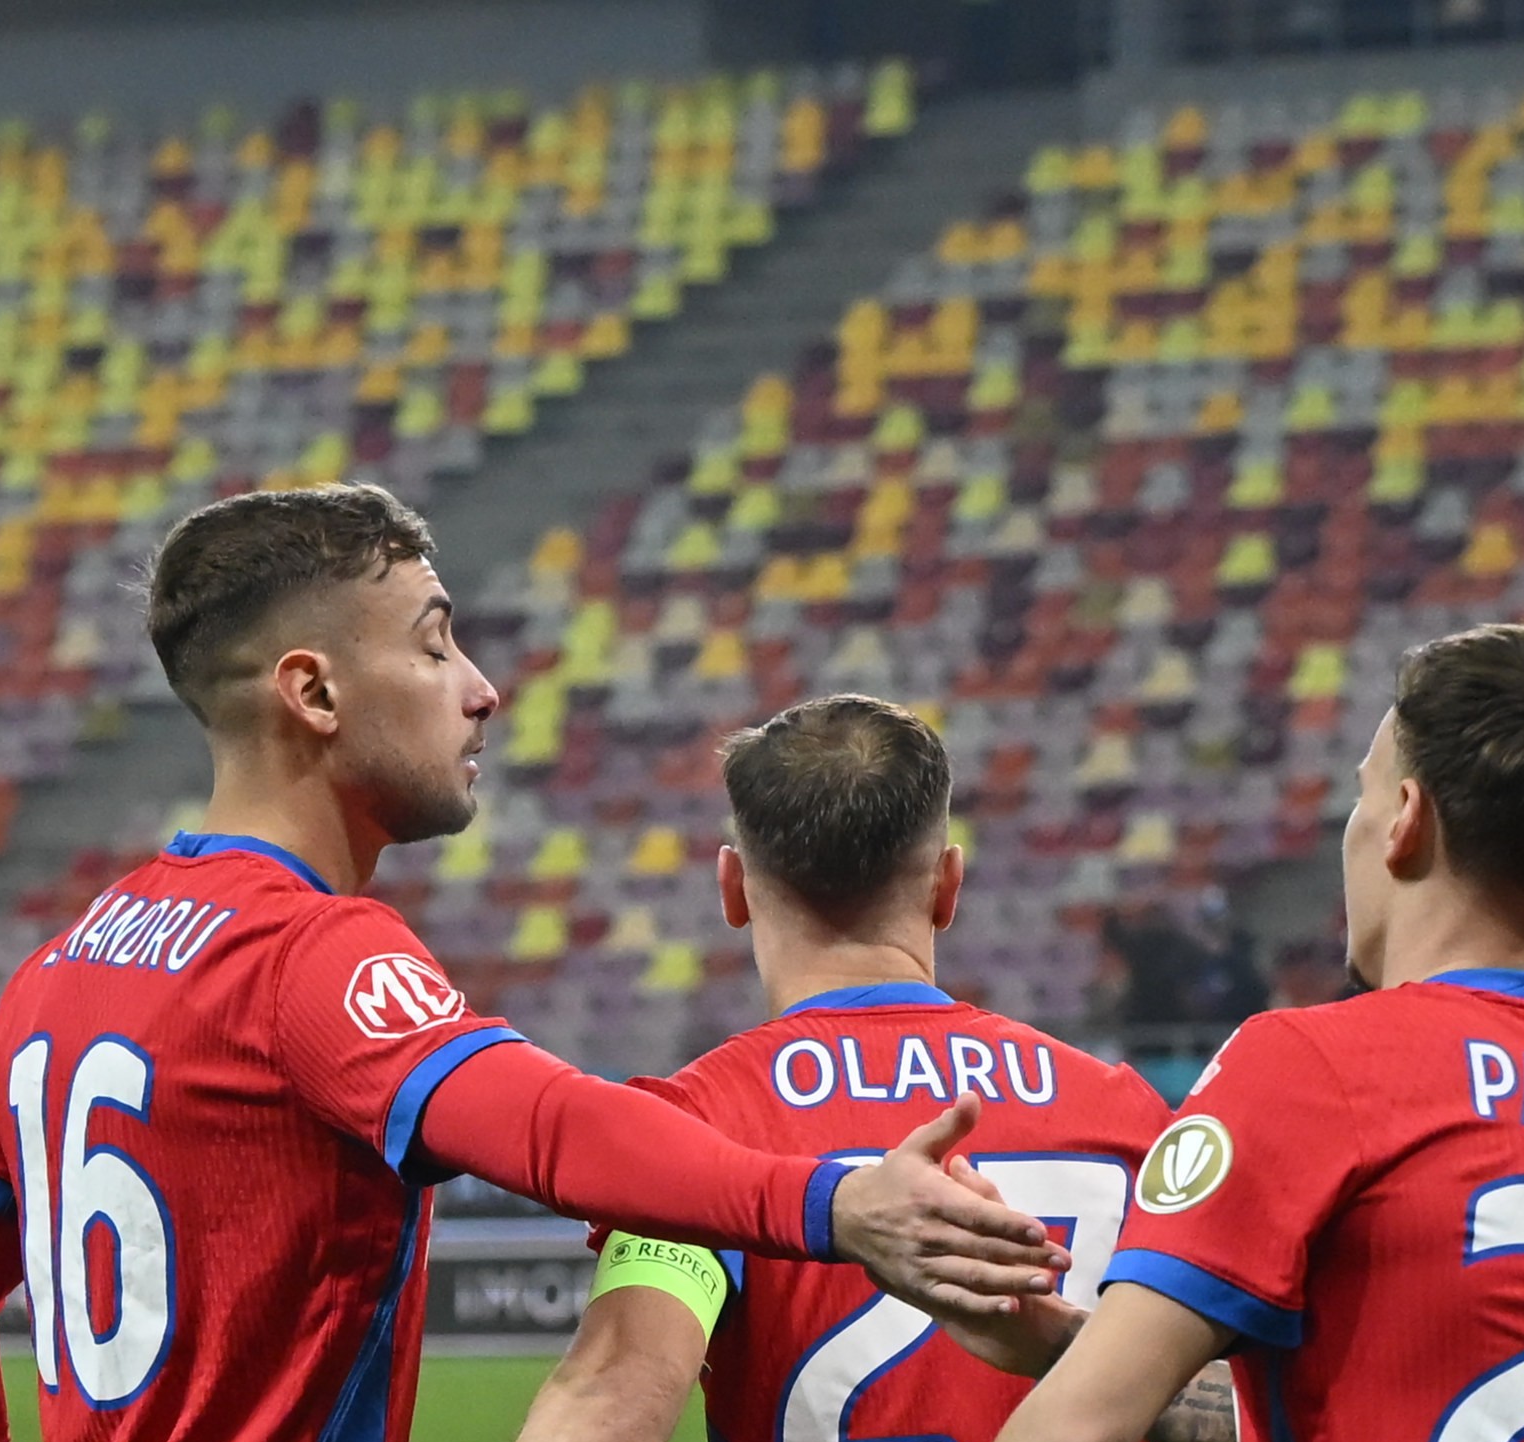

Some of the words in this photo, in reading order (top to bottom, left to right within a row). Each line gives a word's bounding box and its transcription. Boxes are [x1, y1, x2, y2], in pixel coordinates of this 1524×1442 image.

[43, 889, 236, 973] XANDRU
[772, 1033, 1057, 1109] OLARU
[8, 1031, 175, 1411] 16
[638, 1242, 718, 1295] RESPECT
